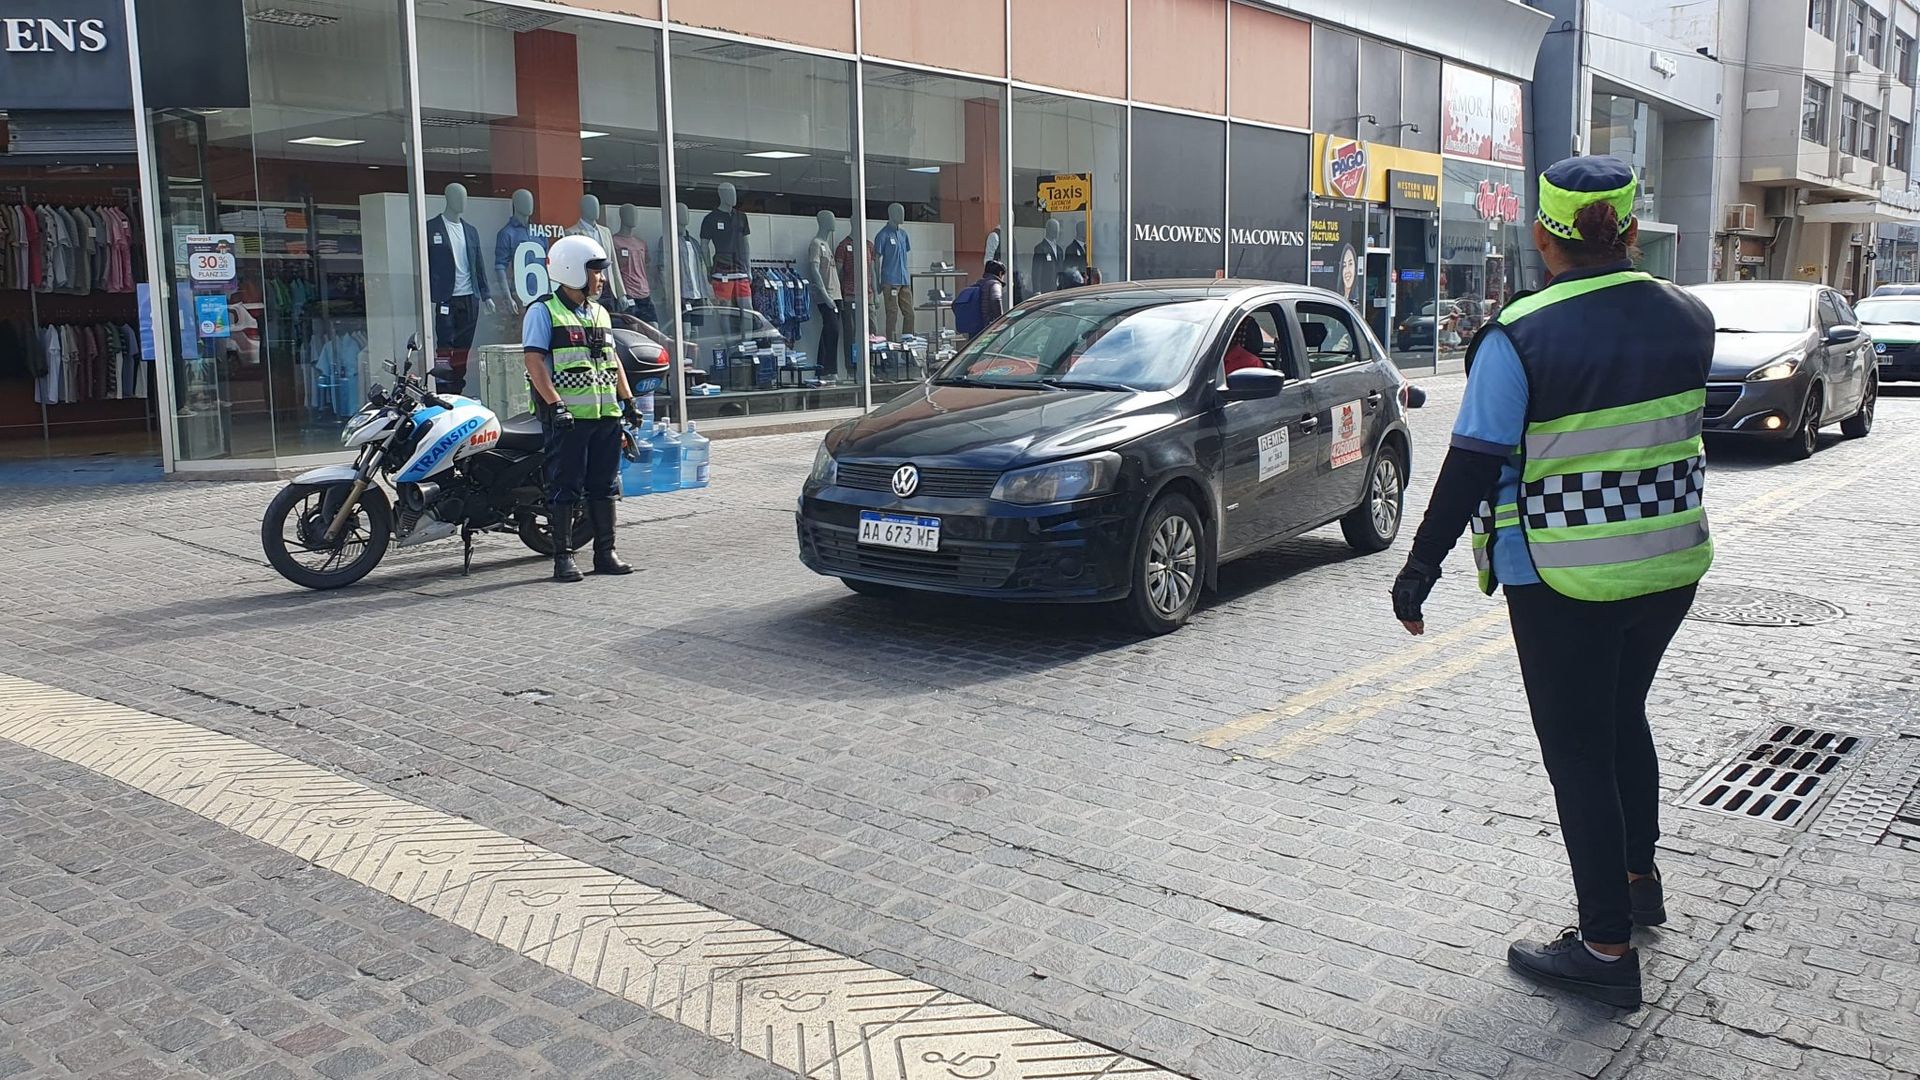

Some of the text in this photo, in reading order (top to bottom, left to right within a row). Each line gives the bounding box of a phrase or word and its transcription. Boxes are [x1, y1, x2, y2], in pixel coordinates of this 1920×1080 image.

[1331, 150, 1364, 178] PAGO
[1046, 185, 1083, 200] Taxis
[529, 223, 566, 238] HASTA
[1134, 223, 1304, 247] MACOWENS MACOWENS
[1327, 221, 1339, 231] TUS
[1311, 231, 1340, 242] FACTURAS
[198, 255, 217, 269] 30
[409, 419, 478, 473] TRANSITO
[1261, 429, 1287, 451] REMIS
[862, 522, 880, 541] AA
[885, 524, 913, 544] 673
